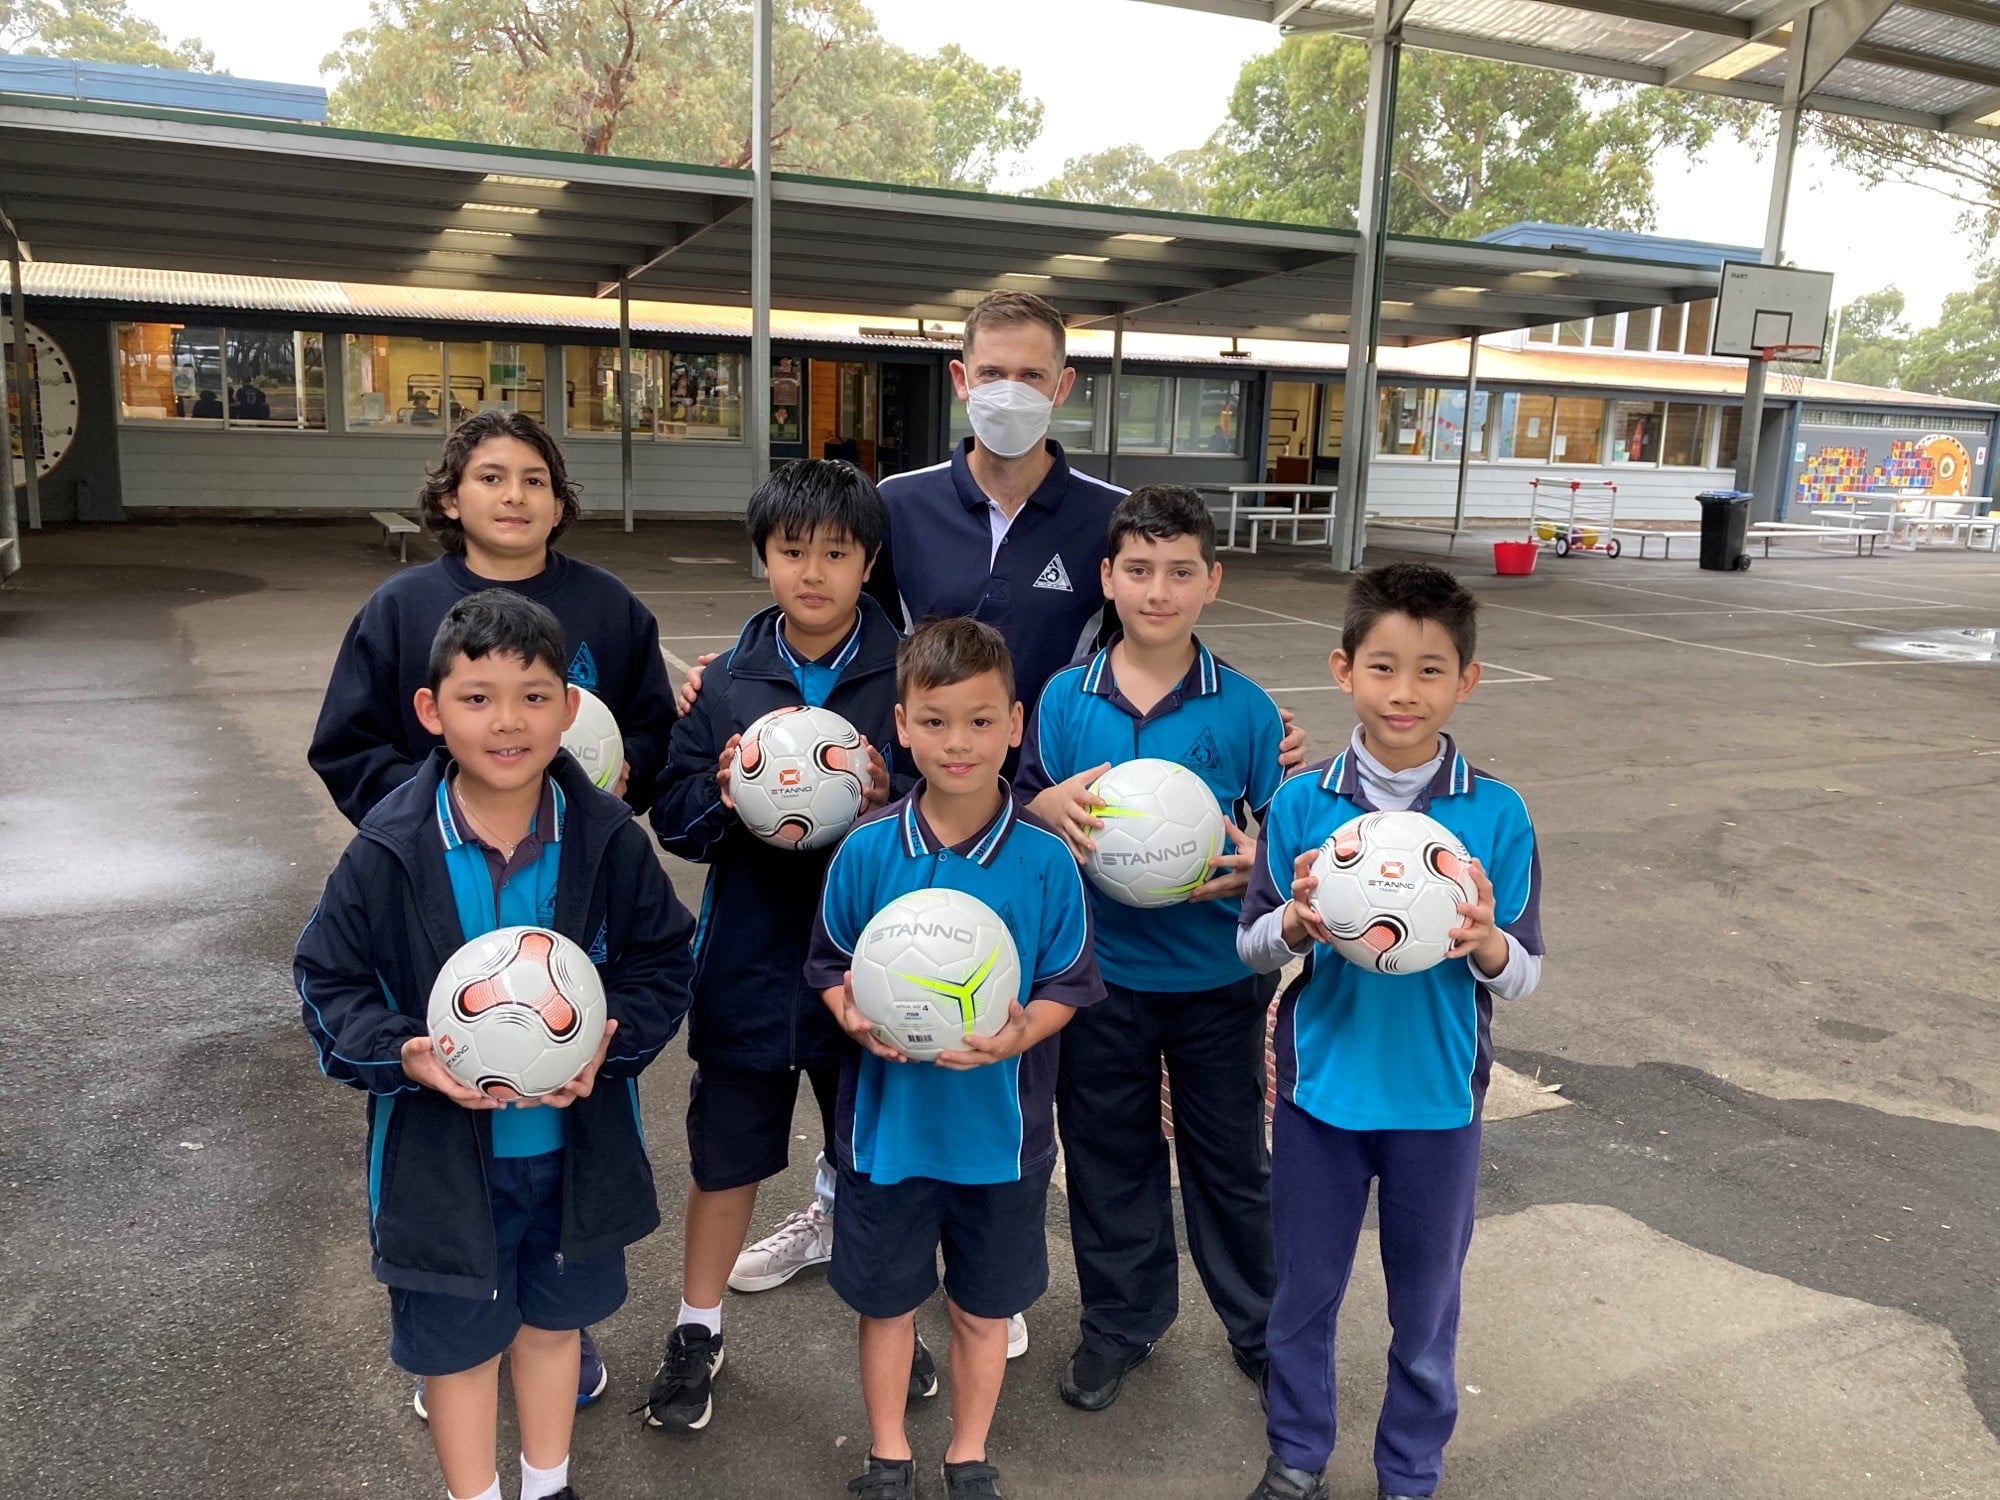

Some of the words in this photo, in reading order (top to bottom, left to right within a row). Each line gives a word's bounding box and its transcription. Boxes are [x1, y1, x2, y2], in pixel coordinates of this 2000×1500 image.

[771, 786, 813, 796] STANNO
[1101, 840, 1198, 867] STANNO
[1368, 879, 1415, 890] STANNO
[869, 923, 975, 945] STANNO
